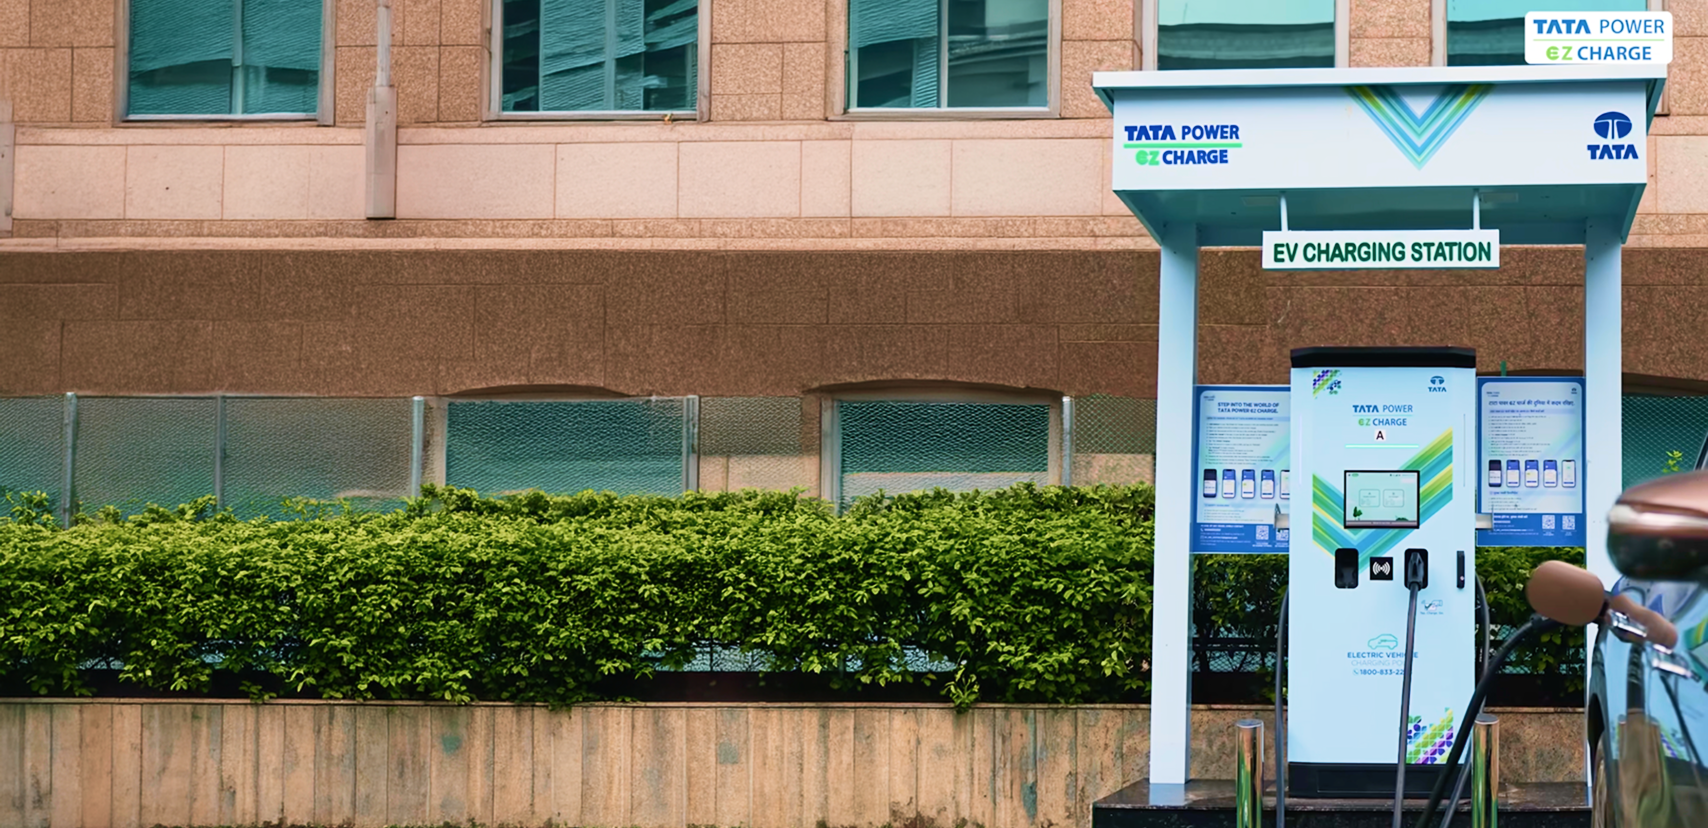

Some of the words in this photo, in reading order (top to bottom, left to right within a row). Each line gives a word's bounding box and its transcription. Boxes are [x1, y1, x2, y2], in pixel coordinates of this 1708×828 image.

[1124, 125, 1177, 141] TATA
[1181, 124, 1240, 140] POWER
[1162, 149, 1229, 165] CHARGE
[1587, 144, 1639, 160] TATA
[1273, 242, 1298, 263] EV
[1303, 241, 1406, 262] CHARGING
[1411, 241, 1492, 262] STATION
[1352, 404, 1379, 413] TATA
[1382, 404, 1413, 413] POWER
[1372, 418, 1407, 426] CHARGE
[1376, 430, 1384, 440] A
